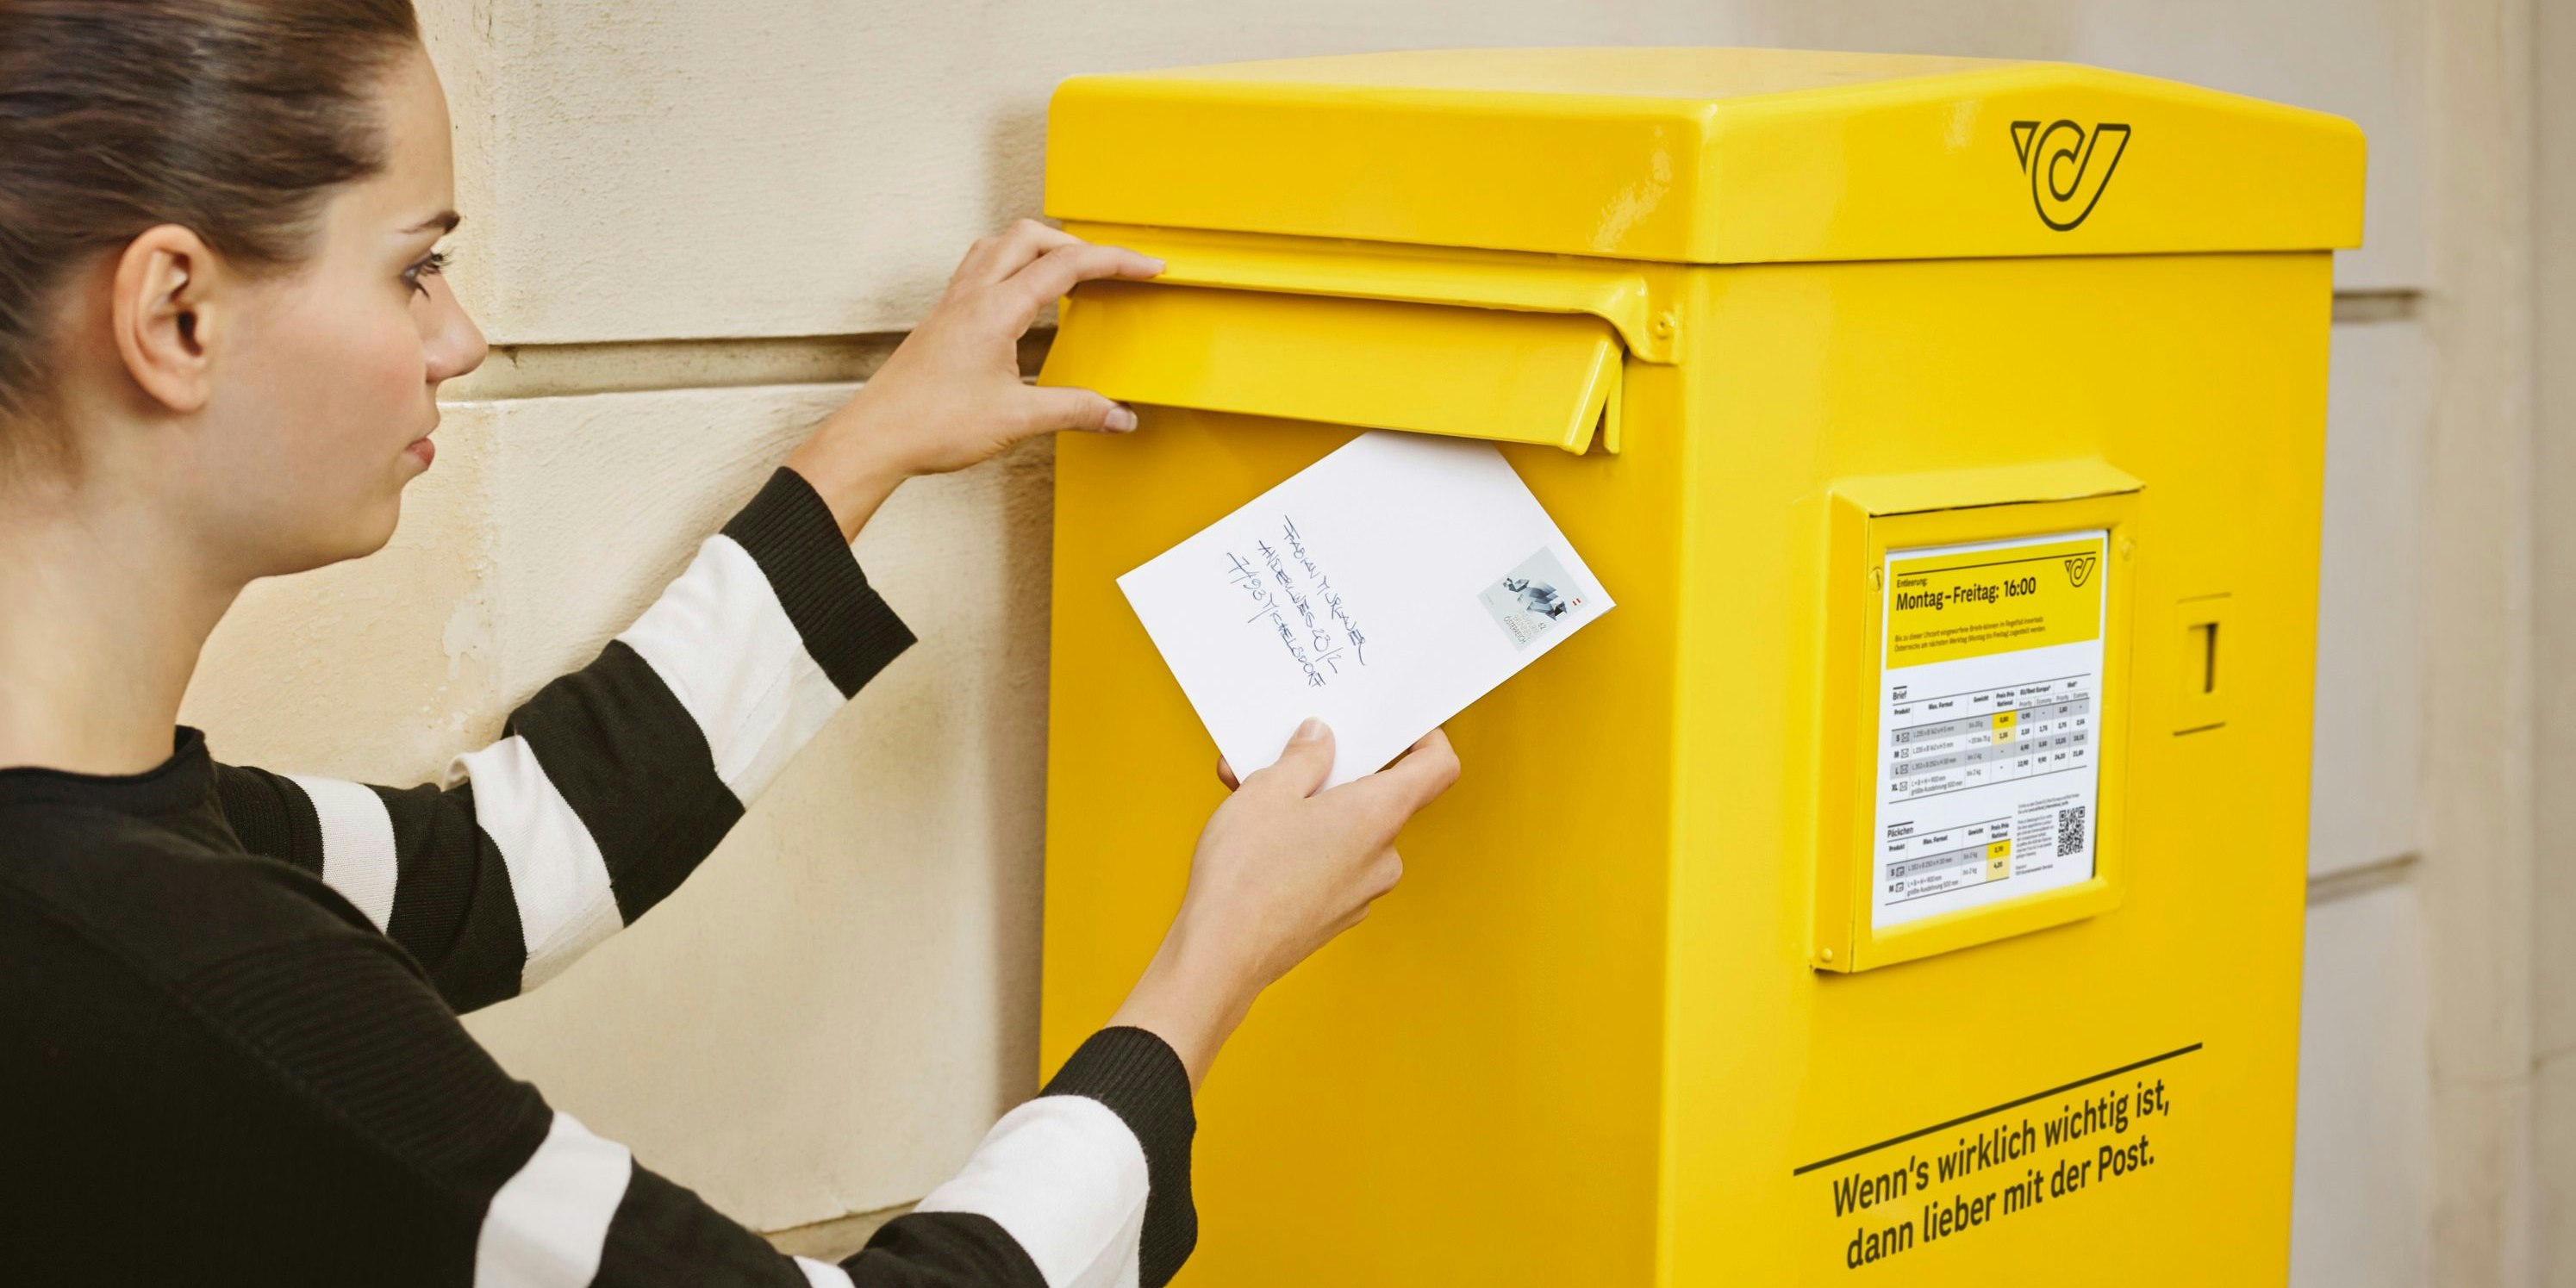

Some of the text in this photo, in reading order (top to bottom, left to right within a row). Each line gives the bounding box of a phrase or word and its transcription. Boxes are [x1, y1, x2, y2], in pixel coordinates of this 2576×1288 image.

[1283, 514, 1319, 579] FABIAN
[1897, 578, 1927, 588] Entleerung:
[2004, 576, 2036, 597] 16:00
[1893, 691, 1906, 700] Brief
[1887, 827, 1913, 837] Päckchen
[1938, 1119, 2036, 1184] wirklich
[2044, 1091, 2129, 1148] wichtig
[2136, 1079, 2170, 1118] ist,
[1846, 1136, 2155, 1269] dann lieber mit der Post.
